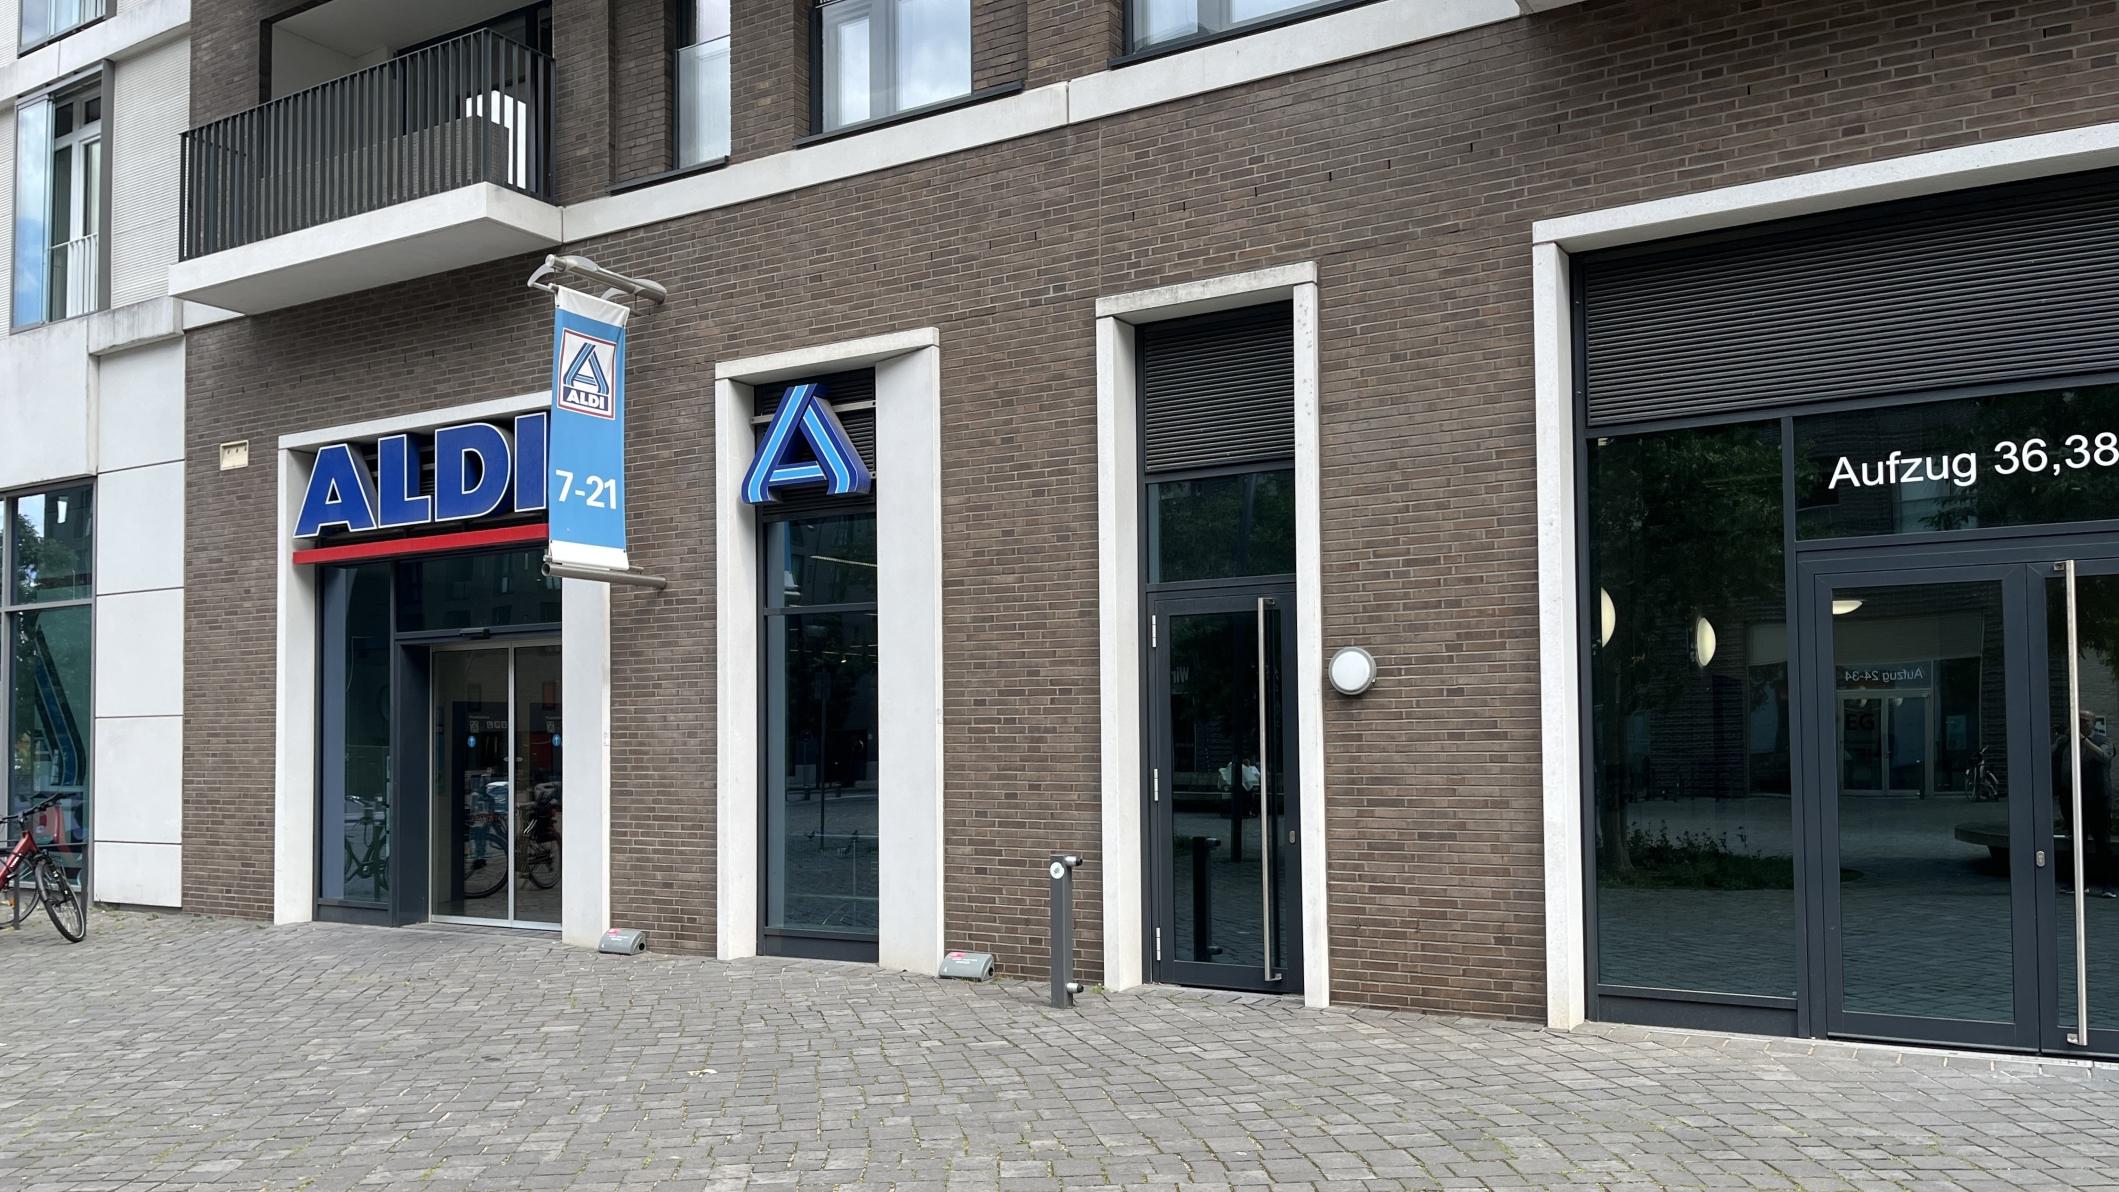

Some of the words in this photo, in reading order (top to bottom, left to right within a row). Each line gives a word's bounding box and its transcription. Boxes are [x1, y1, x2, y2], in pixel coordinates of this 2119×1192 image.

[567, 390, 605, 410] ALDI
[293, 412, 547, 538] ALDI
[1828, 450, 1977, 489] Aufzug
[1994, 432, 2119, 476] 36,38
[555, 469, 617, 510] 7-21
